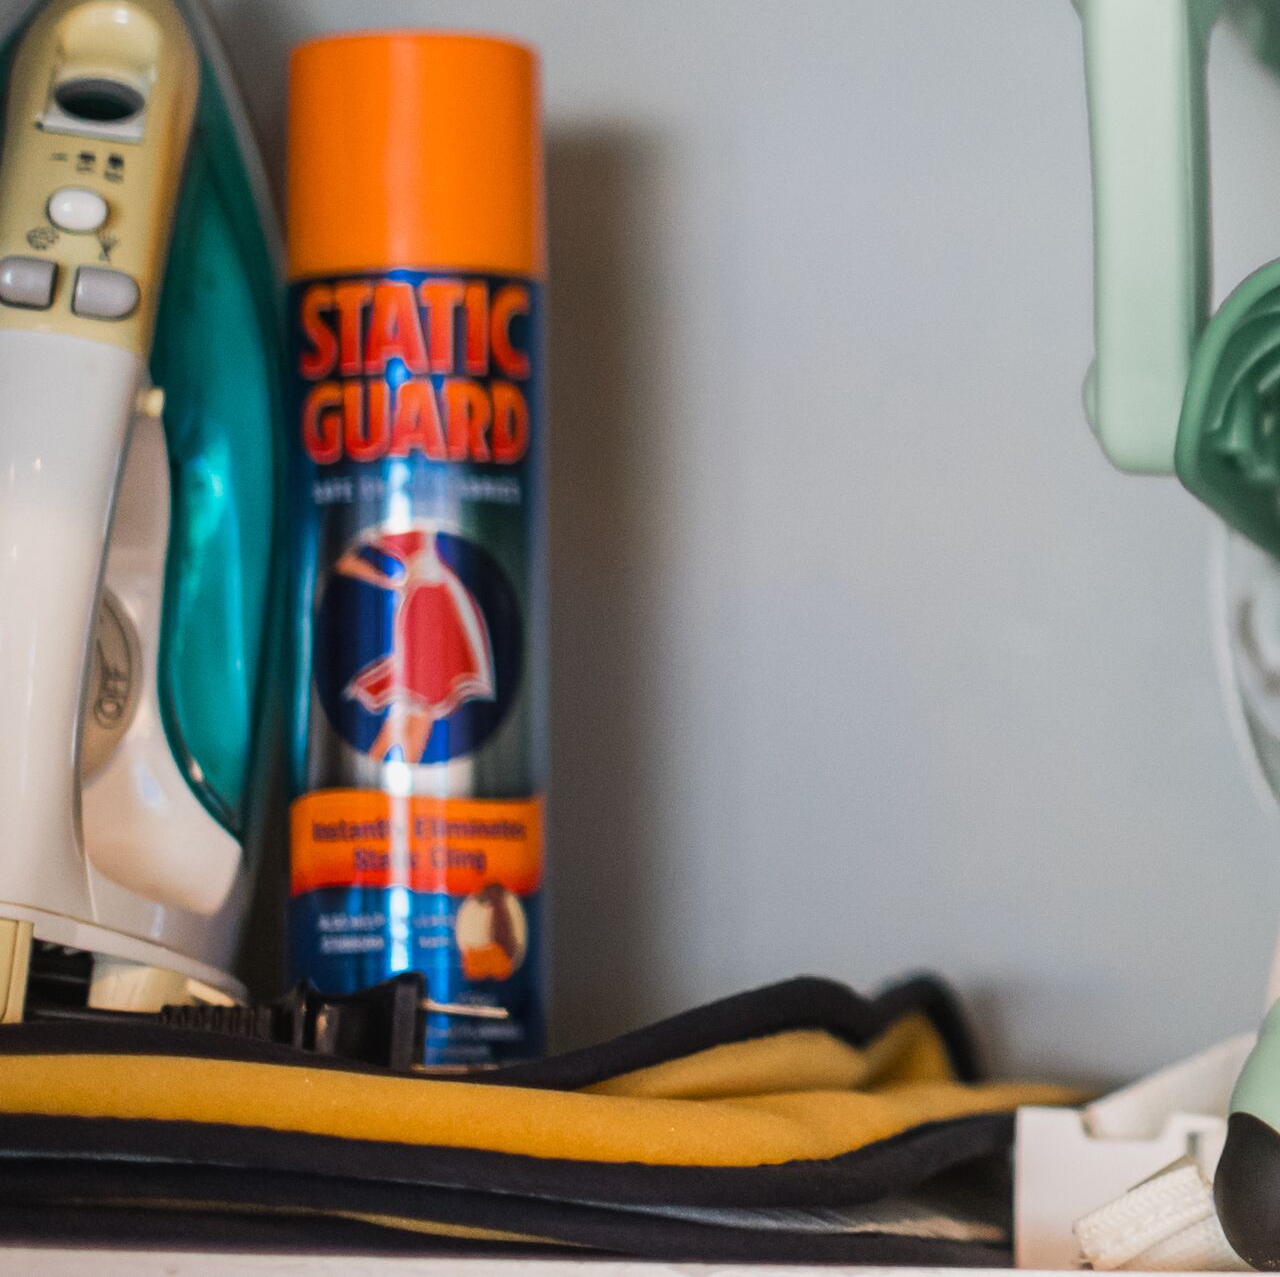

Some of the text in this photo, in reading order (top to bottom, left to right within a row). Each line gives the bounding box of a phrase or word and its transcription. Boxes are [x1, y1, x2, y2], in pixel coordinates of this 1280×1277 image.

[301, 279, 530, 379] STATIC
[303, 379, 529, 465] GUARD
[312, 818, 406, 843] Instantl
